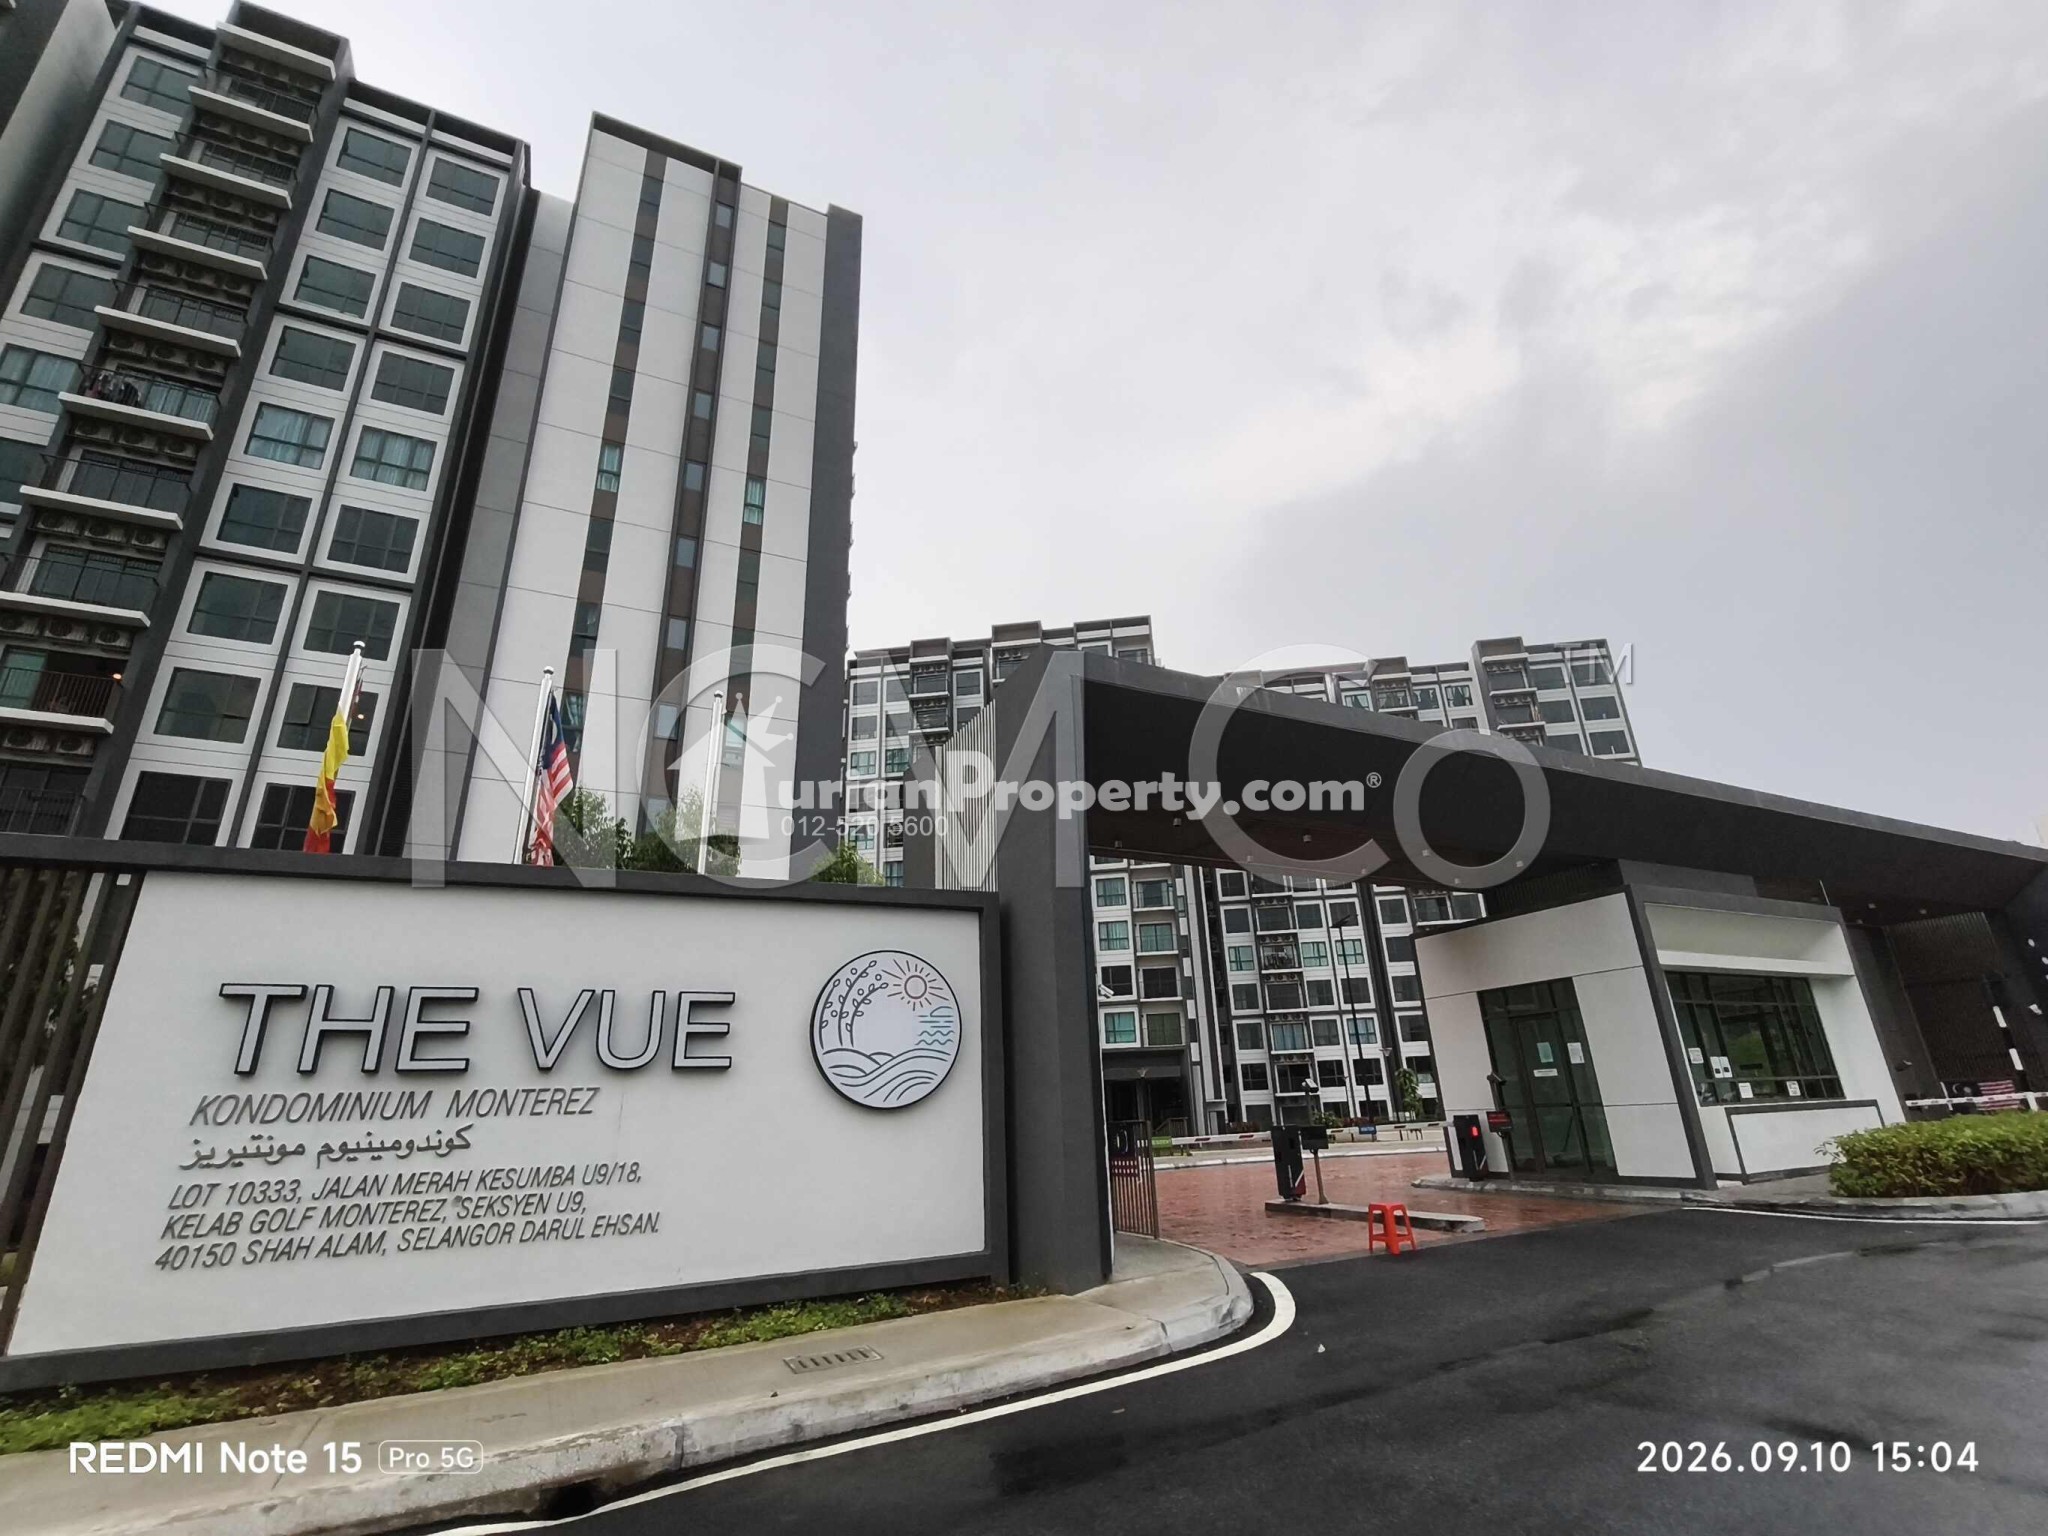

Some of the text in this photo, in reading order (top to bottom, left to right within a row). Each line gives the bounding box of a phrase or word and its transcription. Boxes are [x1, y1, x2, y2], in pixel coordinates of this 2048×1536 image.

[219, 983, 735, 1077] THE VUE
[189, 1086, 601, 1127] KONDOMINIUM MONTEREZ
[178, 1123, 474, 1171] كوندومينيوم مونتيريز
[167, 1161, 642, 1210] LOT 10333, JALAN MERAH KESUMBA U9/18,
[160, 1190, 587, 1240] KELAB GOLF MONTEREZ, SEKSYEN U9,
[154, 1211, 661, 1271] 40150 SHAH ALAM, SELANGOR DARUL EHSAN.
